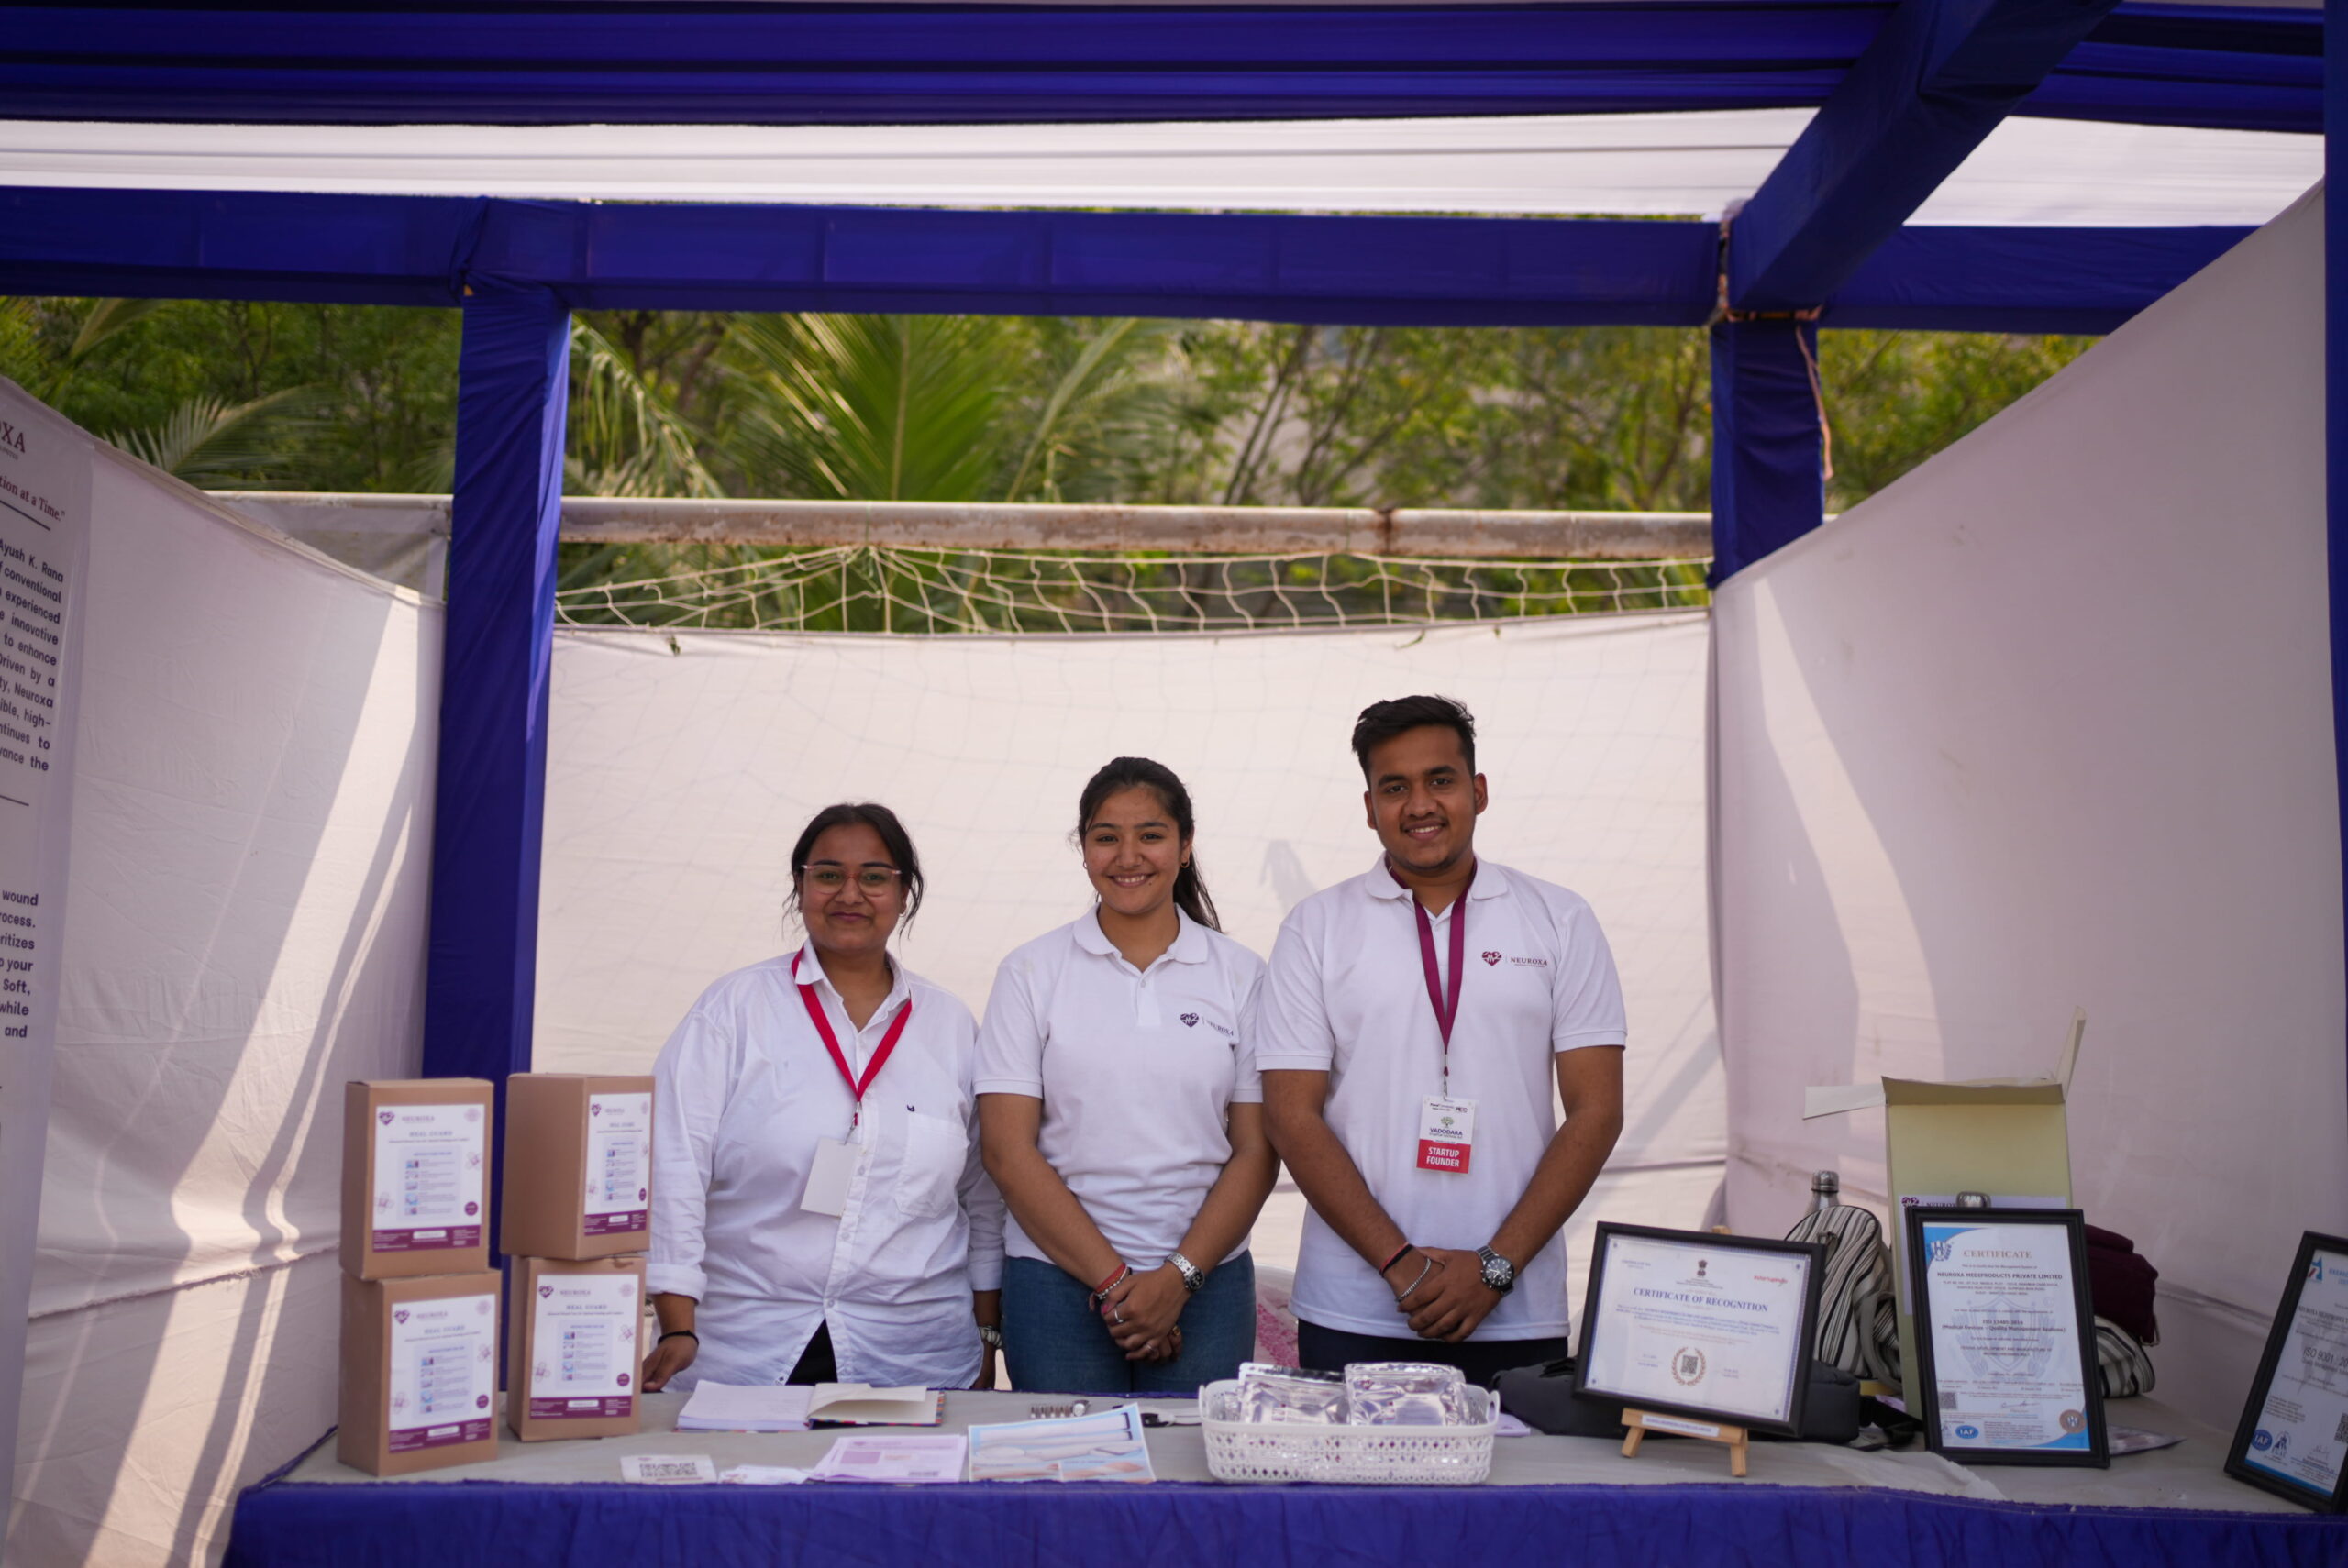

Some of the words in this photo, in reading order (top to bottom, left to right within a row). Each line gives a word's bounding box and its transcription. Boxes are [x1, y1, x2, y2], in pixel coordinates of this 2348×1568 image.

[0, 421, 25, 453] XA
[20, 490, 29, 502] at
[31, 496, 37, 506] a
[28, 554, 37, 569] K.
[42, 561, 63, 583] Rana
[5, 567, 61, 603] conventional
[6, 591, 61, 624] experienced
[11, 612, 58, 645] innovative
[4, 633, 14, 646] to
[18, 642, 57, 666] enhance
[30, 666, 41, 685] by
[48, 677, 55, 687] a
[15, 682, 53, 708] Neuroxa
[24, 708, 51, 728] high-
[39, 736, 50, 750] to
[30, 755, 49, 771] the
[3, 889, 39, 906] wound
[0, 912, 36, 928] ocess.
[6, 959, 34, 972] your
[1511, 956, 1548, 966] NEUROXA
[3, 978, 30, 997] Soft,
[5, 1025, 28, 1038] and
[1428, 1146, 1460, 1158] STARTUP
[1426, 1155, 1460, 1167] FOUNDER
[1963, 1249, 2032, 1260] CERTIFICATE
[1634, 1287, 1691, 1302] CERTIFICATE
[1692, 1296, 1704, 1304] OF
[1706, 1297, 1769, 1312] RECOGNITION
[1959, 1427, 1976, 1437] IAF
